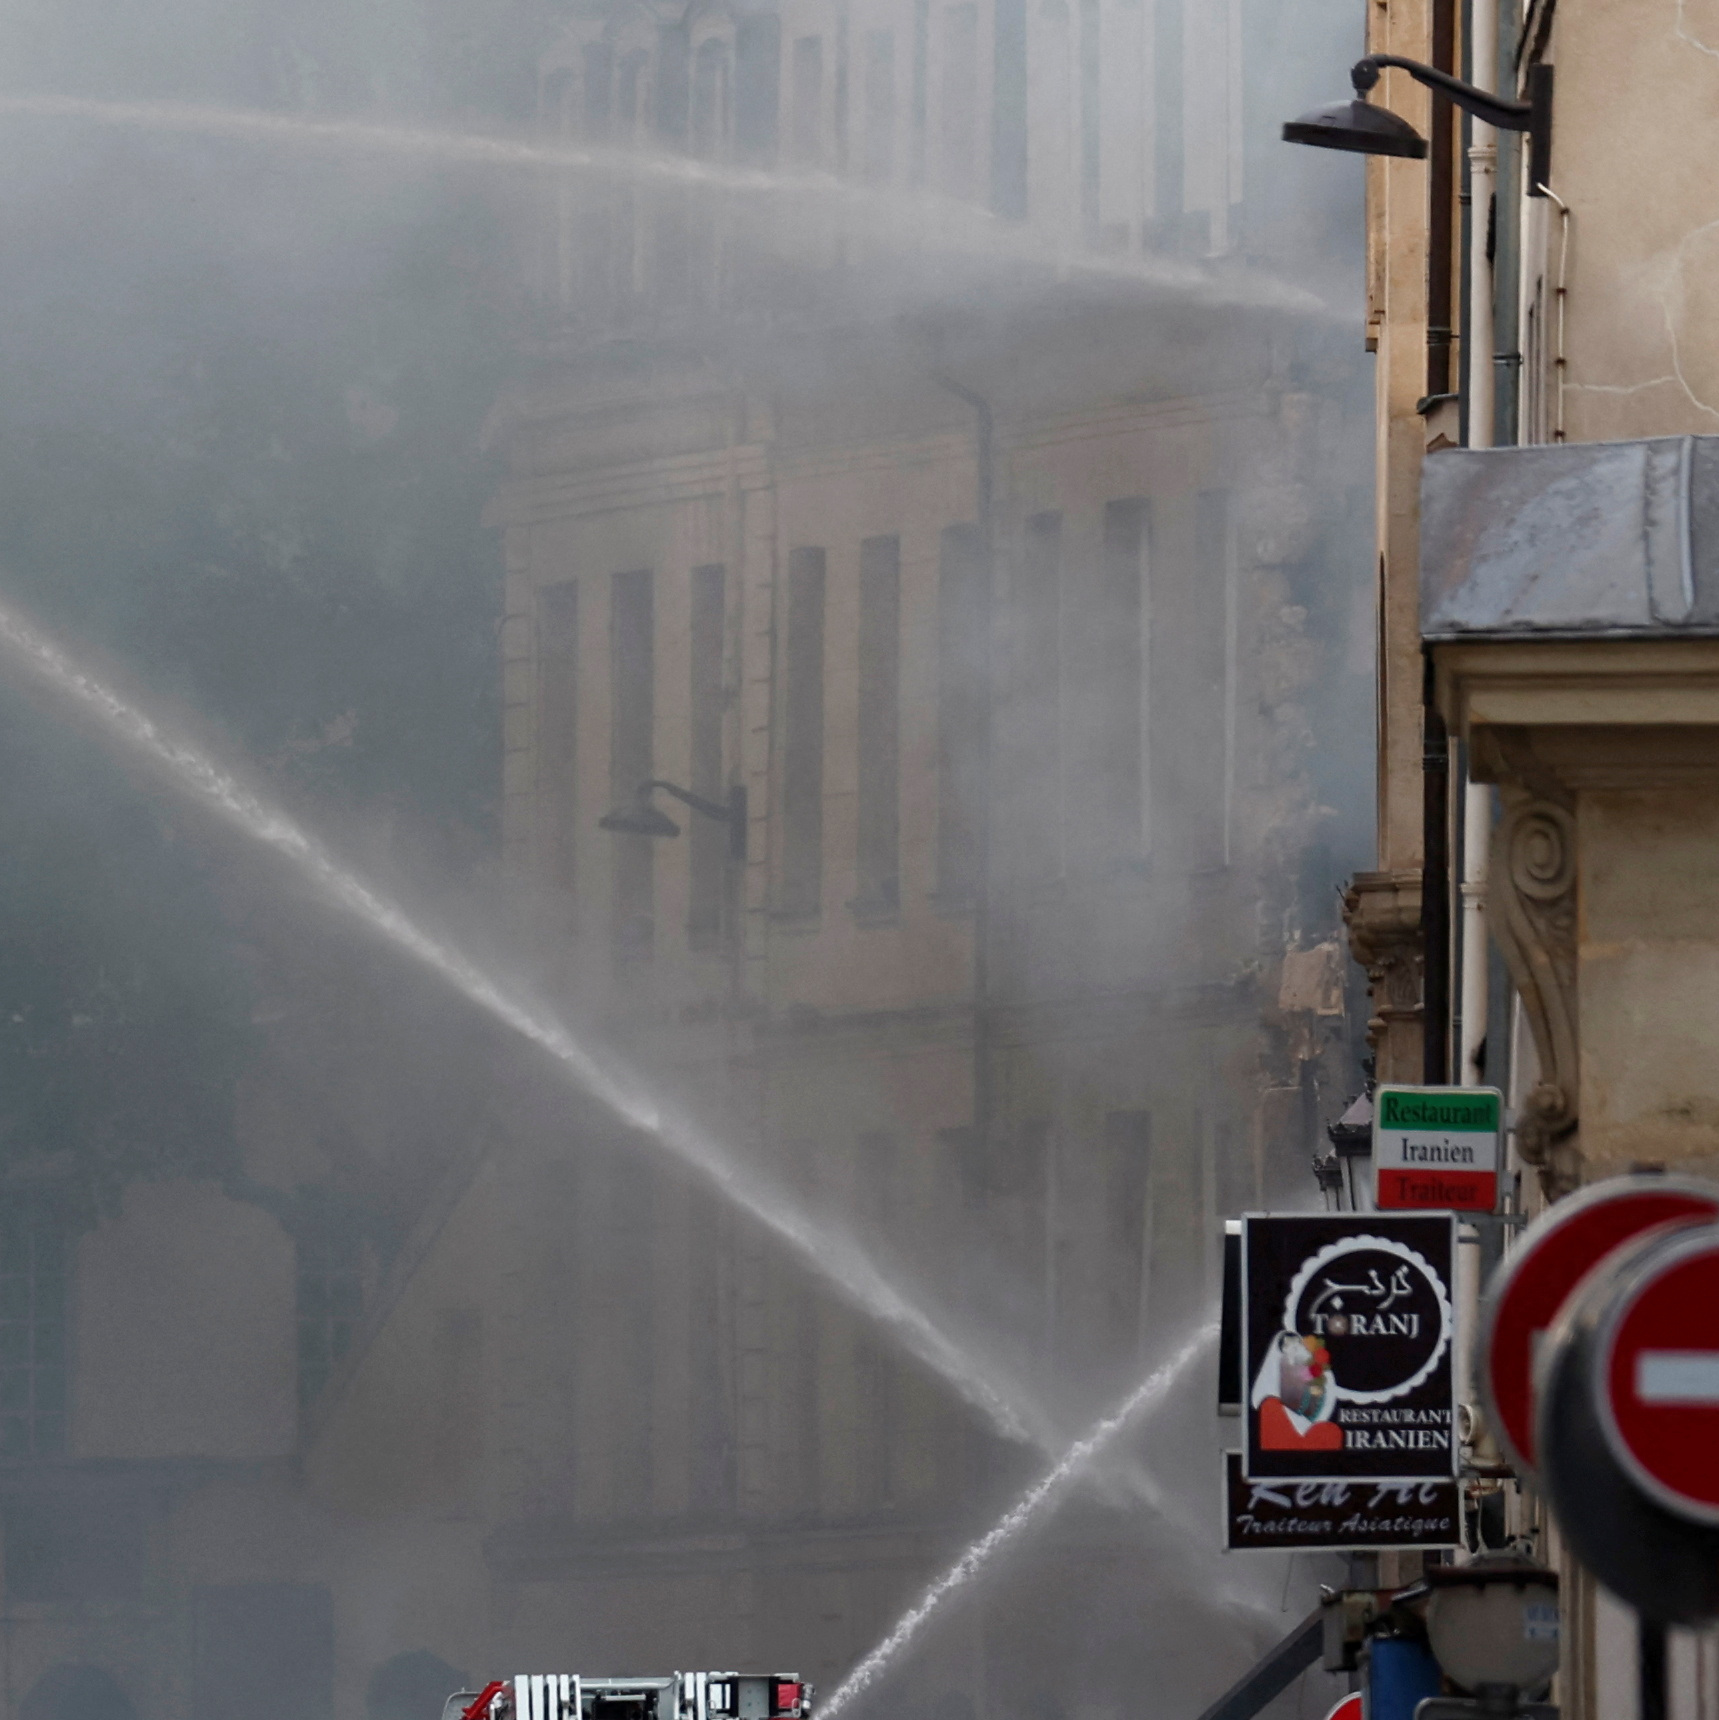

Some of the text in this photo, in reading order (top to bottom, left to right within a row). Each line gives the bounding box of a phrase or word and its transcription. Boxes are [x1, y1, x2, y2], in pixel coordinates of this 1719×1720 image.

[1385, 1097, 1492, 1125] Restaurant
[1401, 1138, 1474, 1163] Iranien
[1396, 1175, 1478, 1202] Traiteur
[1338, 1408, 1451, 1424] RESTAURANT
[1344, 1429, 1450, 1450] IRANIEN
[1235, 1512, 1451, 1538] Traiteur Asiatique
